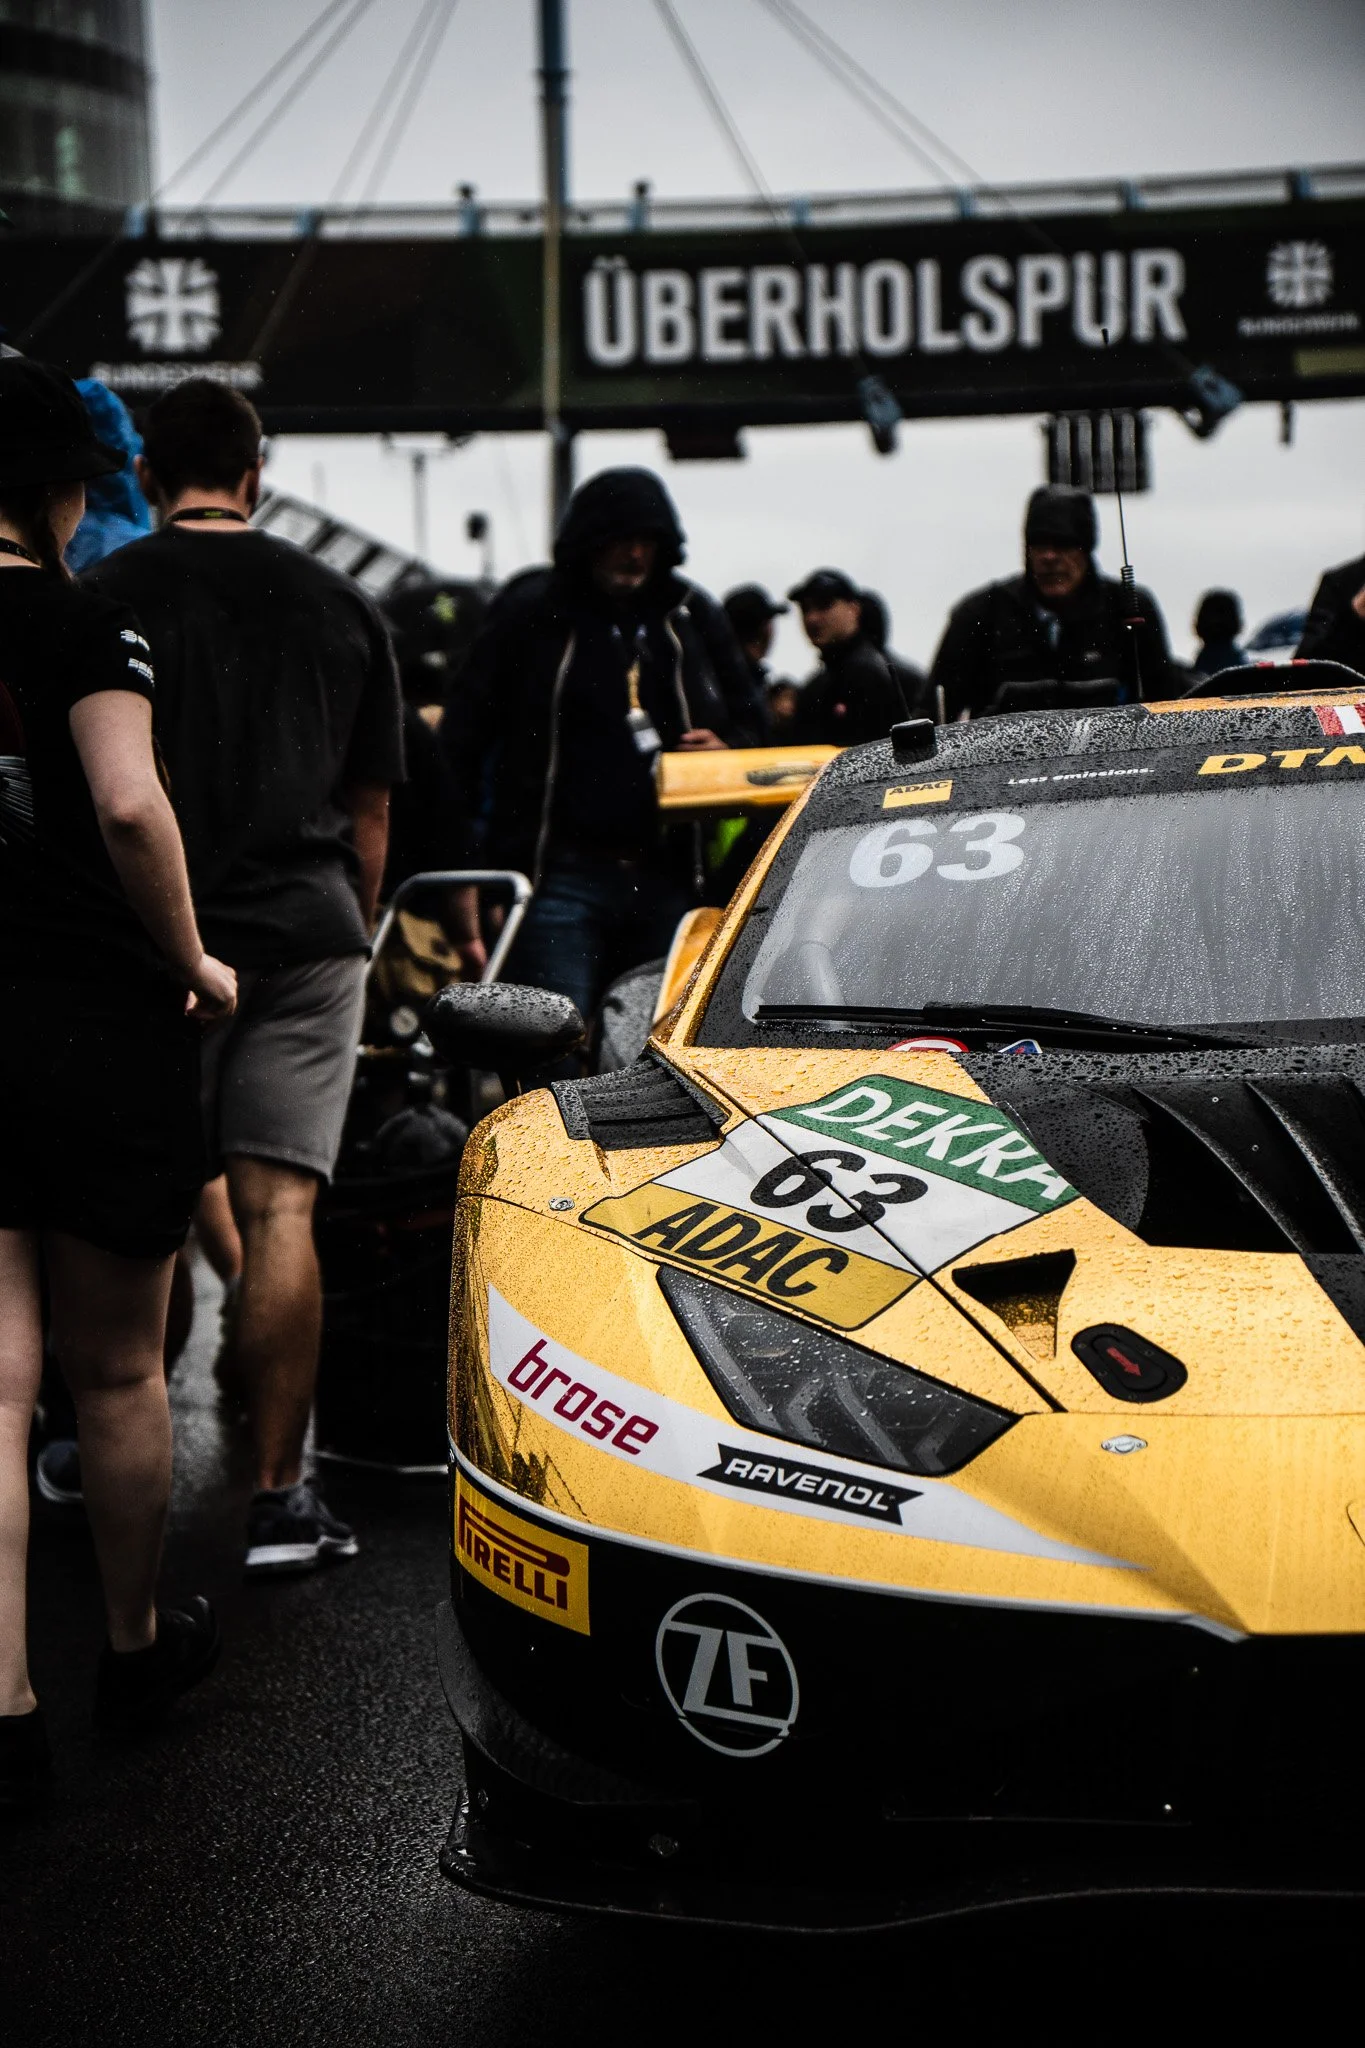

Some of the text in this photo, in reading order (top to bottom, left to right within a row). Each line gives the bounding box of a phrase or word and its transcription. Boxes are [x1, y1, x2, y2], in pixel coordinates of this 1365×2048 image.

[583, 248, 1188, 368] ÜBERHOLSPUR
[888, 779, 950, 796] ADAC
[849, 811, 1026, 888] 63
[750, 1149, 929, 1233] 63
[796, 1085, 1072, 1200] DEKRA
[635, 1201, 849, 1298] ADAC
[507, 1338, 659, 1456] brose
[724, 1457, 889, 1512] RAVENOL
[458, 1493, 570, 1611] PIRELLI
[665, 1619, 793, 1735] ZF
